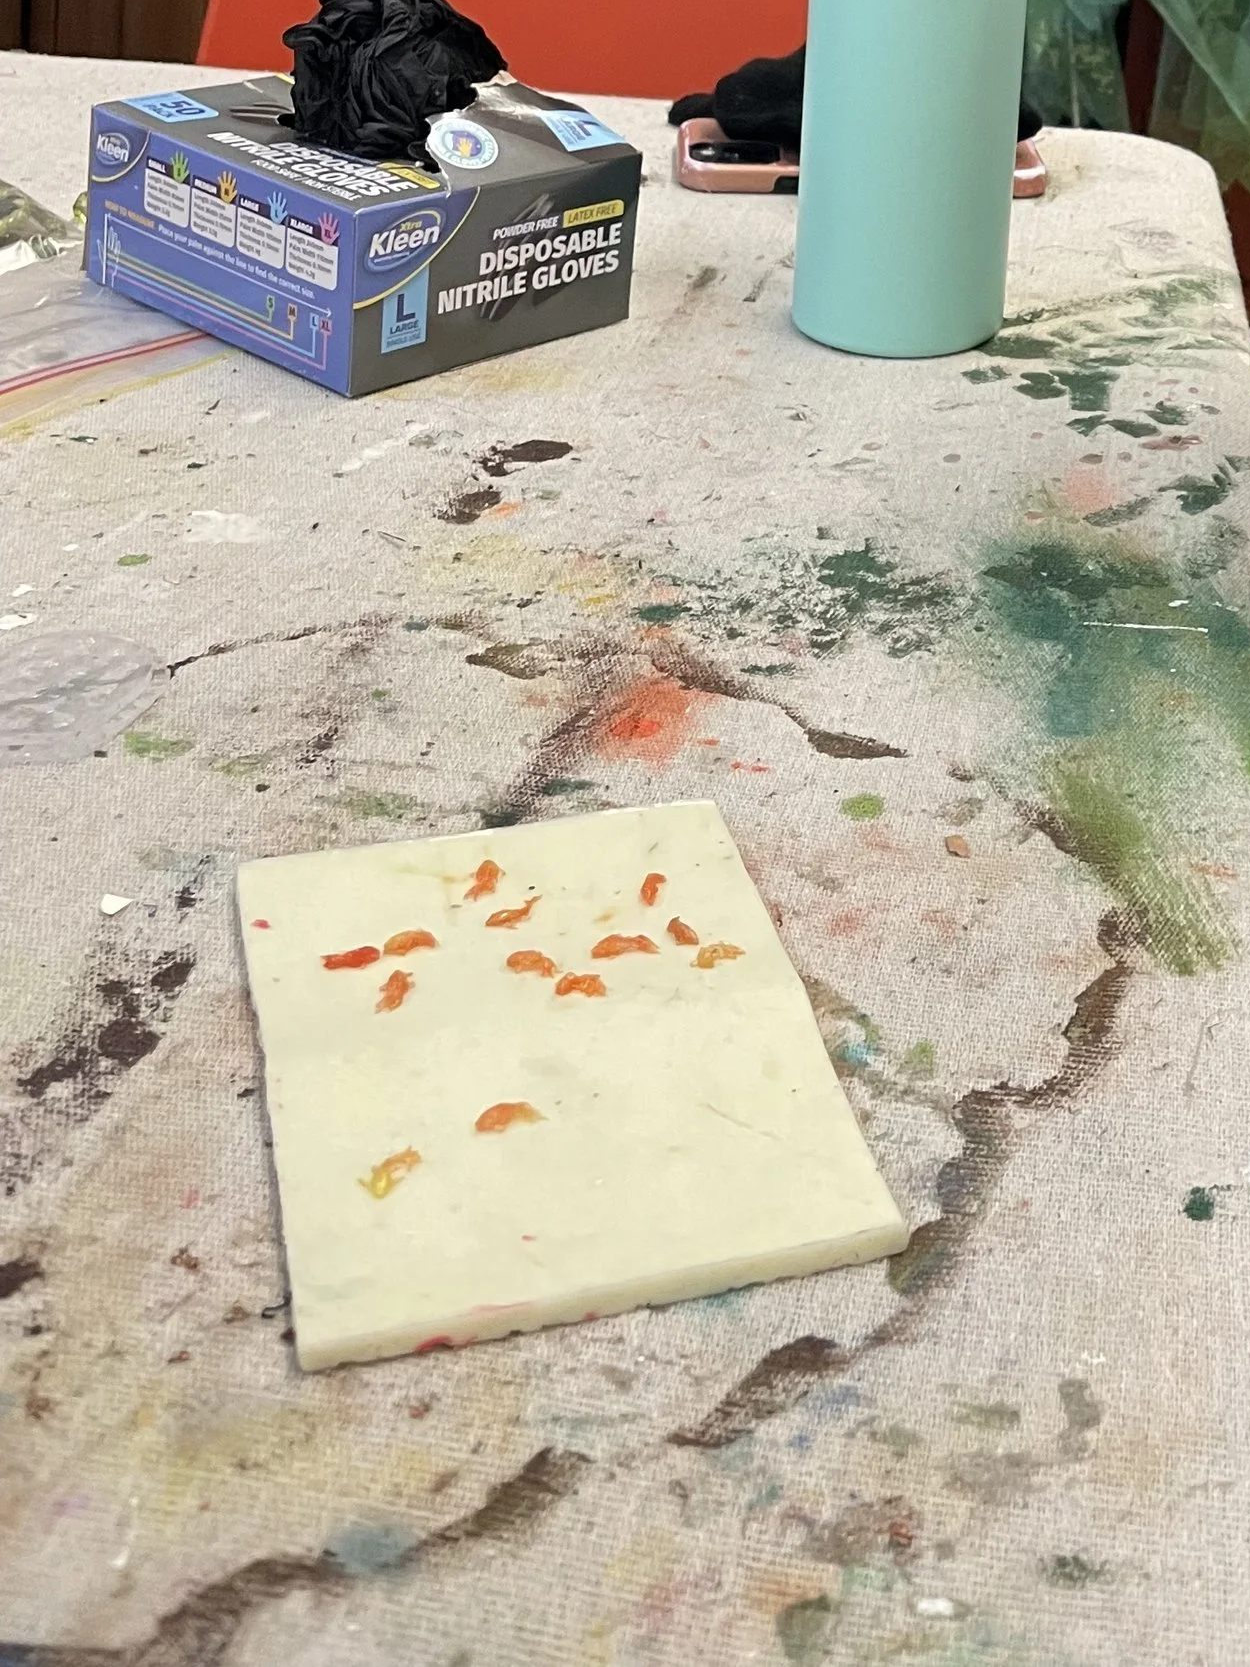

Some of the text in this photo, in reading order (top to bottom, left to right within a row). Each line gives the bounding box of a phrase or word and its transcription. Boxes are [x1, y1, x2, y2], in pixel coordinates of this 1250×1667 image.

[160, 100, 206, 116] 50
[573, 120, 601, 137] L
[97, 134, 129, 163] Kleen
[207, 132, 296, 166] NITRILE
[291, 162, 389, 197] GLOVES
[269, 142, 419, 192] DISPOSABLE
[290, 218, 314, 234] XLARGE
[400, 221, 422, 232] Xtra
[493, 204, 618, 241] POWDER FREE LATEX FREE
[369, 226, 440, 258] Kleen
[479, 222, 622, 276] DISPOSABLE
[438, 250, 620, 314] NITRILE GLOVES
[268, 296, 274, 308] S
[288, 304, 296, 317] M
[396, 294, 416, 323] L
[311, 315, 318, 326] L
[321, 319, 331, 331] XL
[390, 320, 419, 334] LARGE
